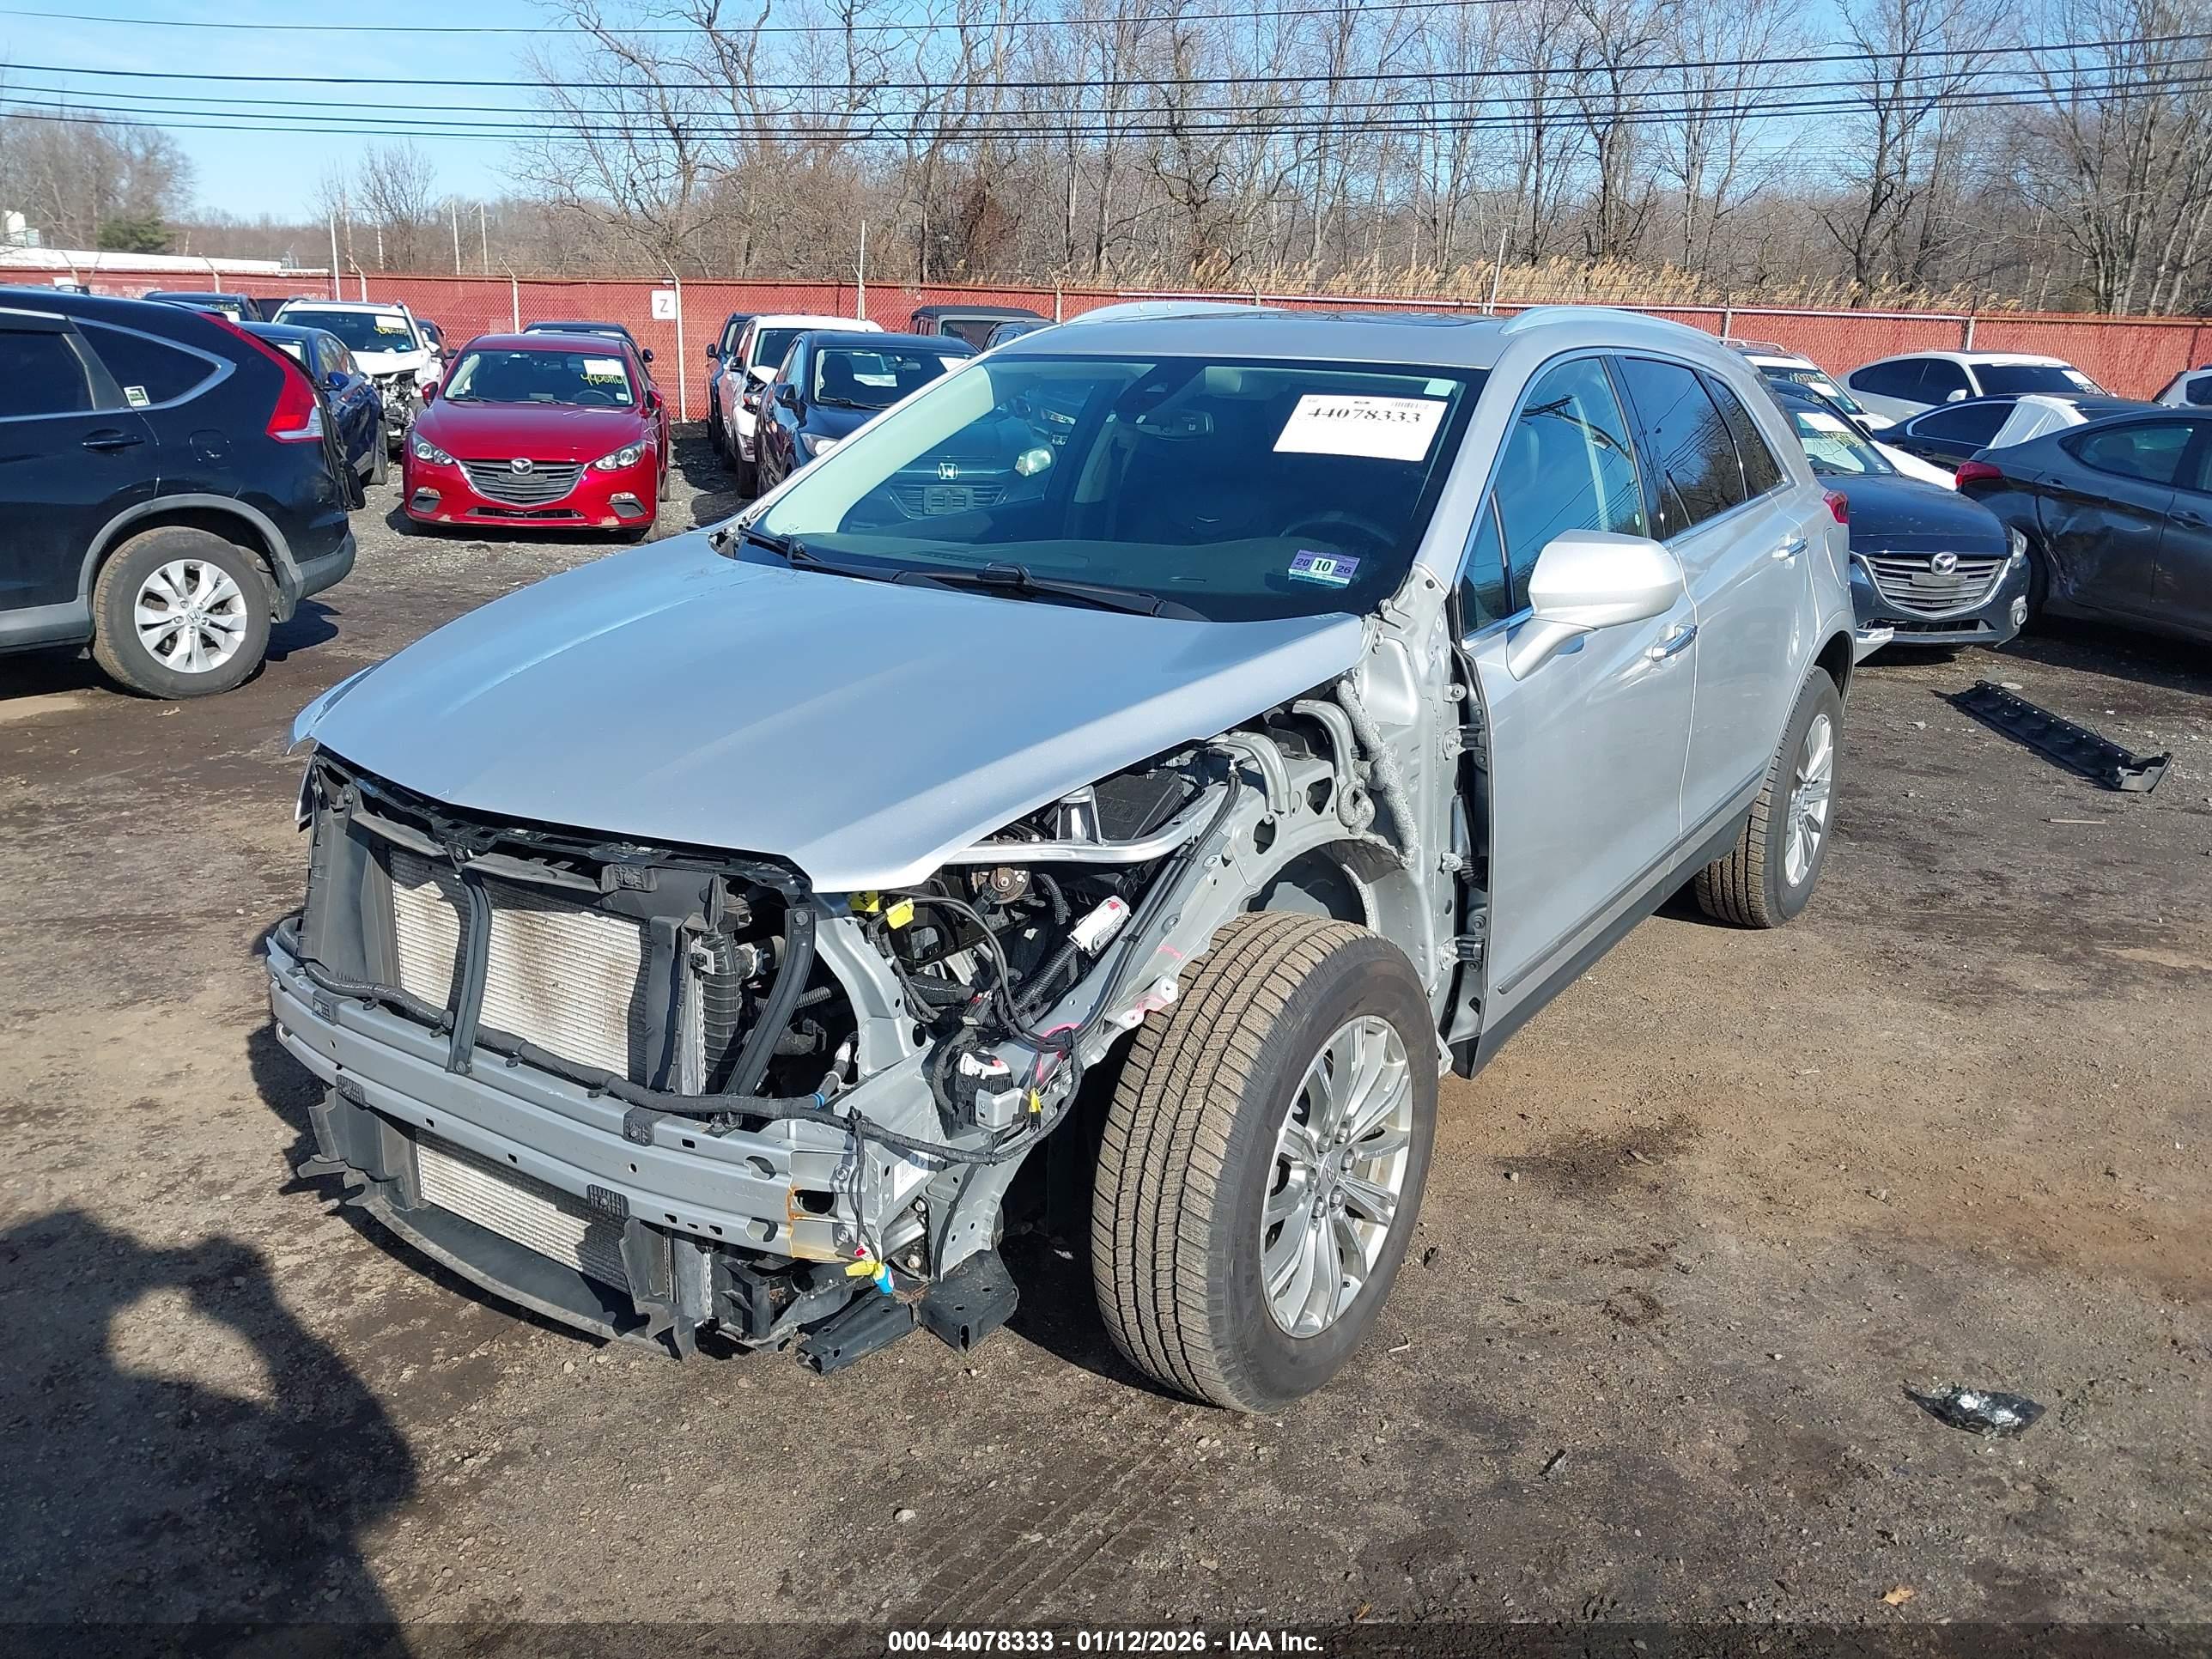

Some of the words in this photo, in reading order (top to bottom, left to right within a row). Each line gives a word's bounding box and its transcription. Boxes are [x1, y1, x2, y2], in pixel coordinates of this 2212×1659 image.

[659, 298, 669, 313] Z
[1307, 406, 1421, 424] 44078333
[1295, 557, 1310, 567] 20
[1313, 559, 1332, 572] 10
[1335, 565, 1352, 574] 26
